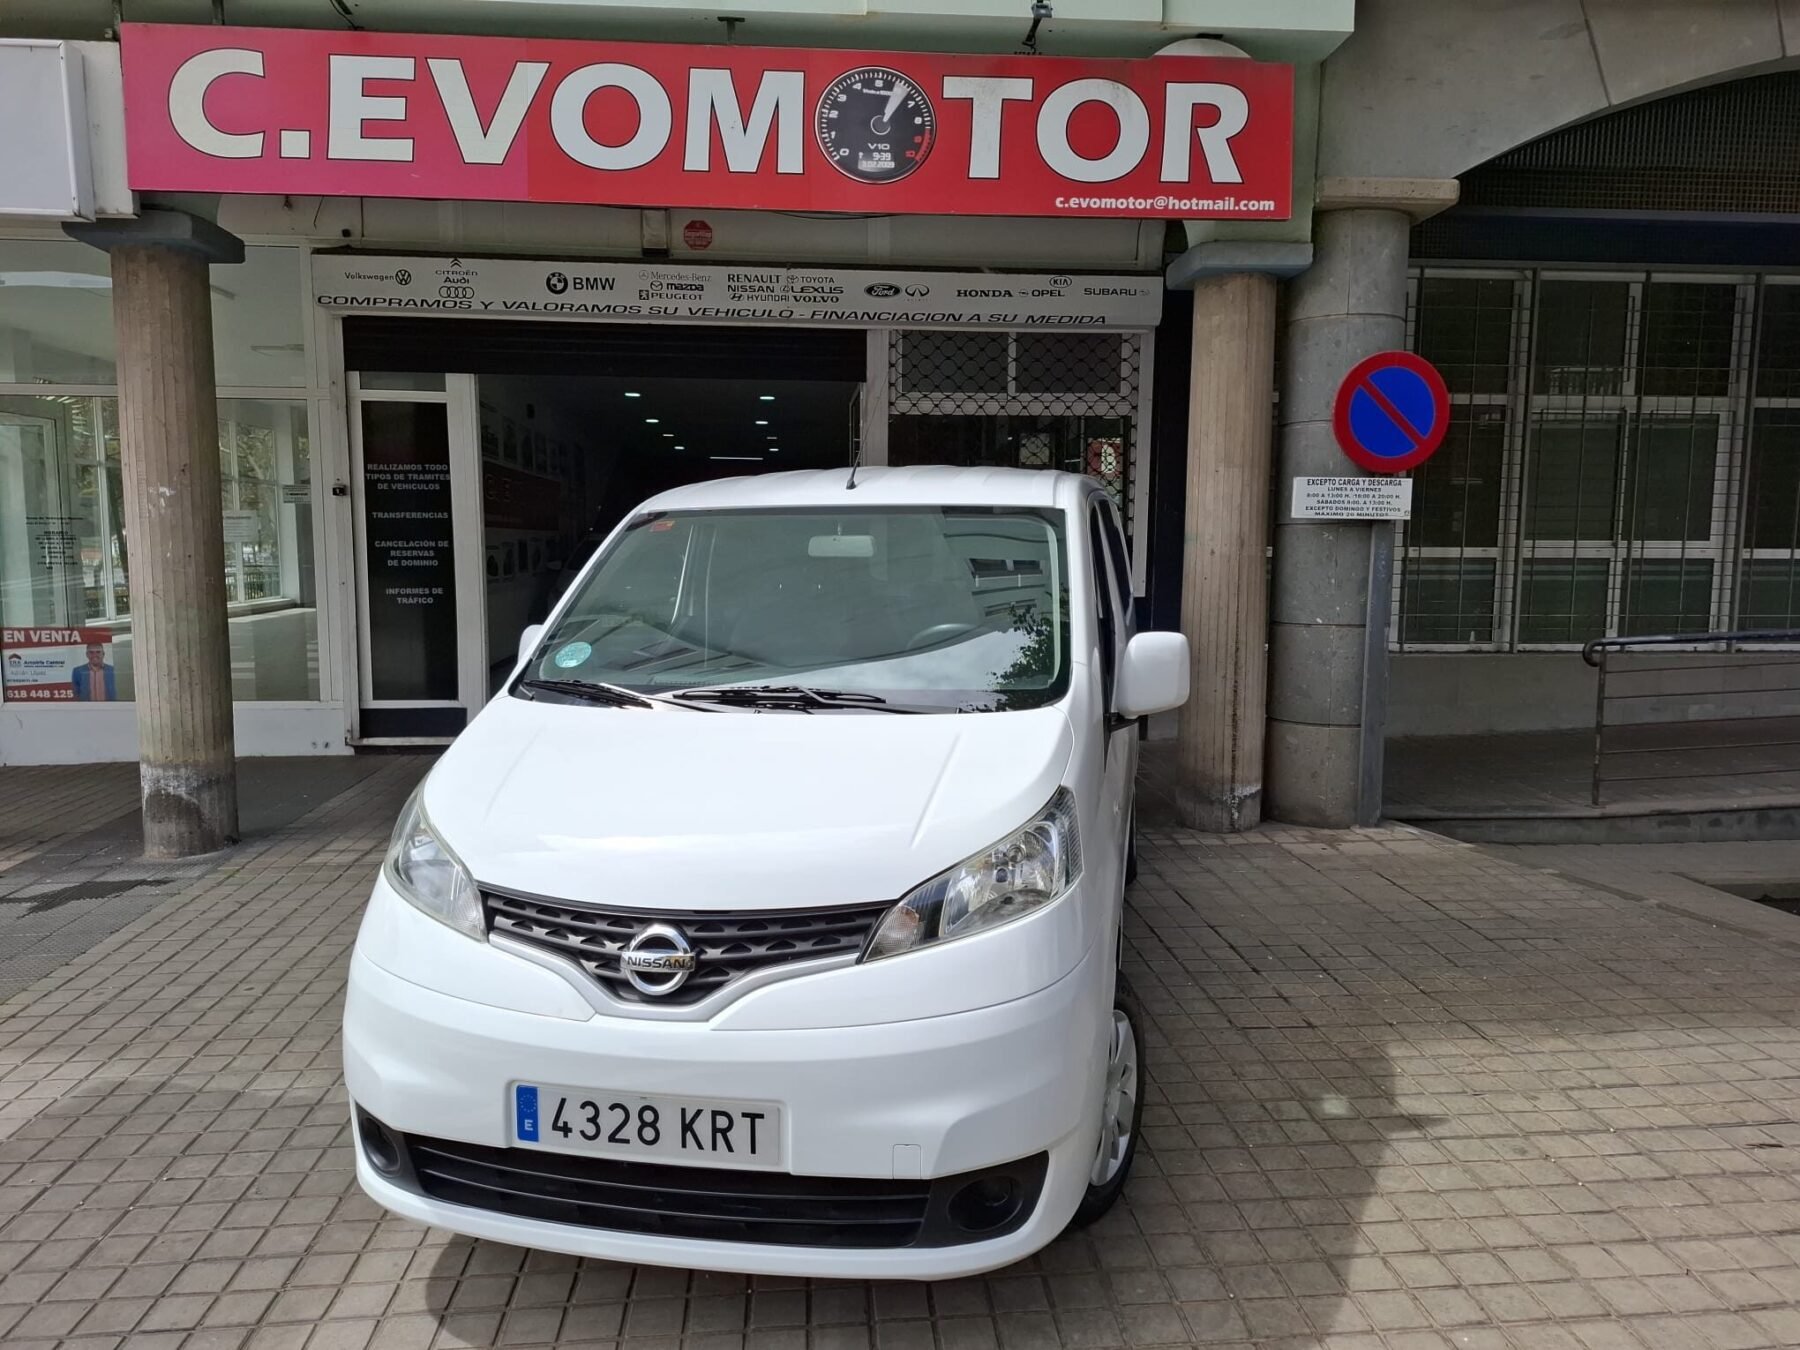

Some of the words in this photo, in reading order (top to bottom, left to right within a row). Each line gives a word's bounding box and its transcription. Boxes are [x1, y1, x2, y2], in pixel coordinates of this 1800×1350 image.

[1055, 196, 1276, 212] c.evomotor@hotmail.com
[345, 272, 394, 282] Volkswagen
[443, 276, 470, 285] Audi
[651, 270, 712, 282] Mercedes-Benz
[727, 273, 782, 284] RENAULT
[800, 276, 835, 284] TOYOTA
[573, 277, 616, 291] BMW
[666, 282, 705, 292] mazda
[1053, 278, 1069, 287] KIA
[727, 285, 775, 293] NISSAN
[790, 285, 844, 294] LEXUS
[871, 285, 896, 297] Ford
[956, 289, 1014, 298] HONDA
[1031, 289, 1065, 297] OPEL
[1083, 288, 1137, 296] SUBARU
[651, 292, 703, 301] PEUGEOT
[746, 294, 790, 302] HYUNDAI
[792, 295, 840, 303] VOLVO
[317, 295, 473, 310] COMPRAMOS
[480, 301, 495, 310] Y
[502, 301, 642, 314] VALORAMOS
[648, 306, 679, 316] SU
[687, 307, 794, 319] VEHICULO
[810, 309, 963, 322] FINANCIACION
[967, 313, 982, 322] A
[987, 313, 1018, 323] SU
[1025, 315, 1107, 325] MEDIDA
[408, 473, 451, 481] TRAMITES
[1307, 478, 1337, 486] EXCEPTO
[1338, 478, 1360, 486] CARGA
[1368, 479, 1402, 487] DESCARGA
[372, 511, 449, 519] TRANSFERENCIAS
[3, 630, 25, 643] EN
[29, 630, 82, 643] VENTA
[29, 689, 51, 699] 448
[53, 689, 74, 699] 125
[627, 956, 687, 969] NISSAN
[524, 1119, 534, 1131] E
[551, 1097, 661, 1147] 4328
[680, 1107, 766, 1155] KRT
